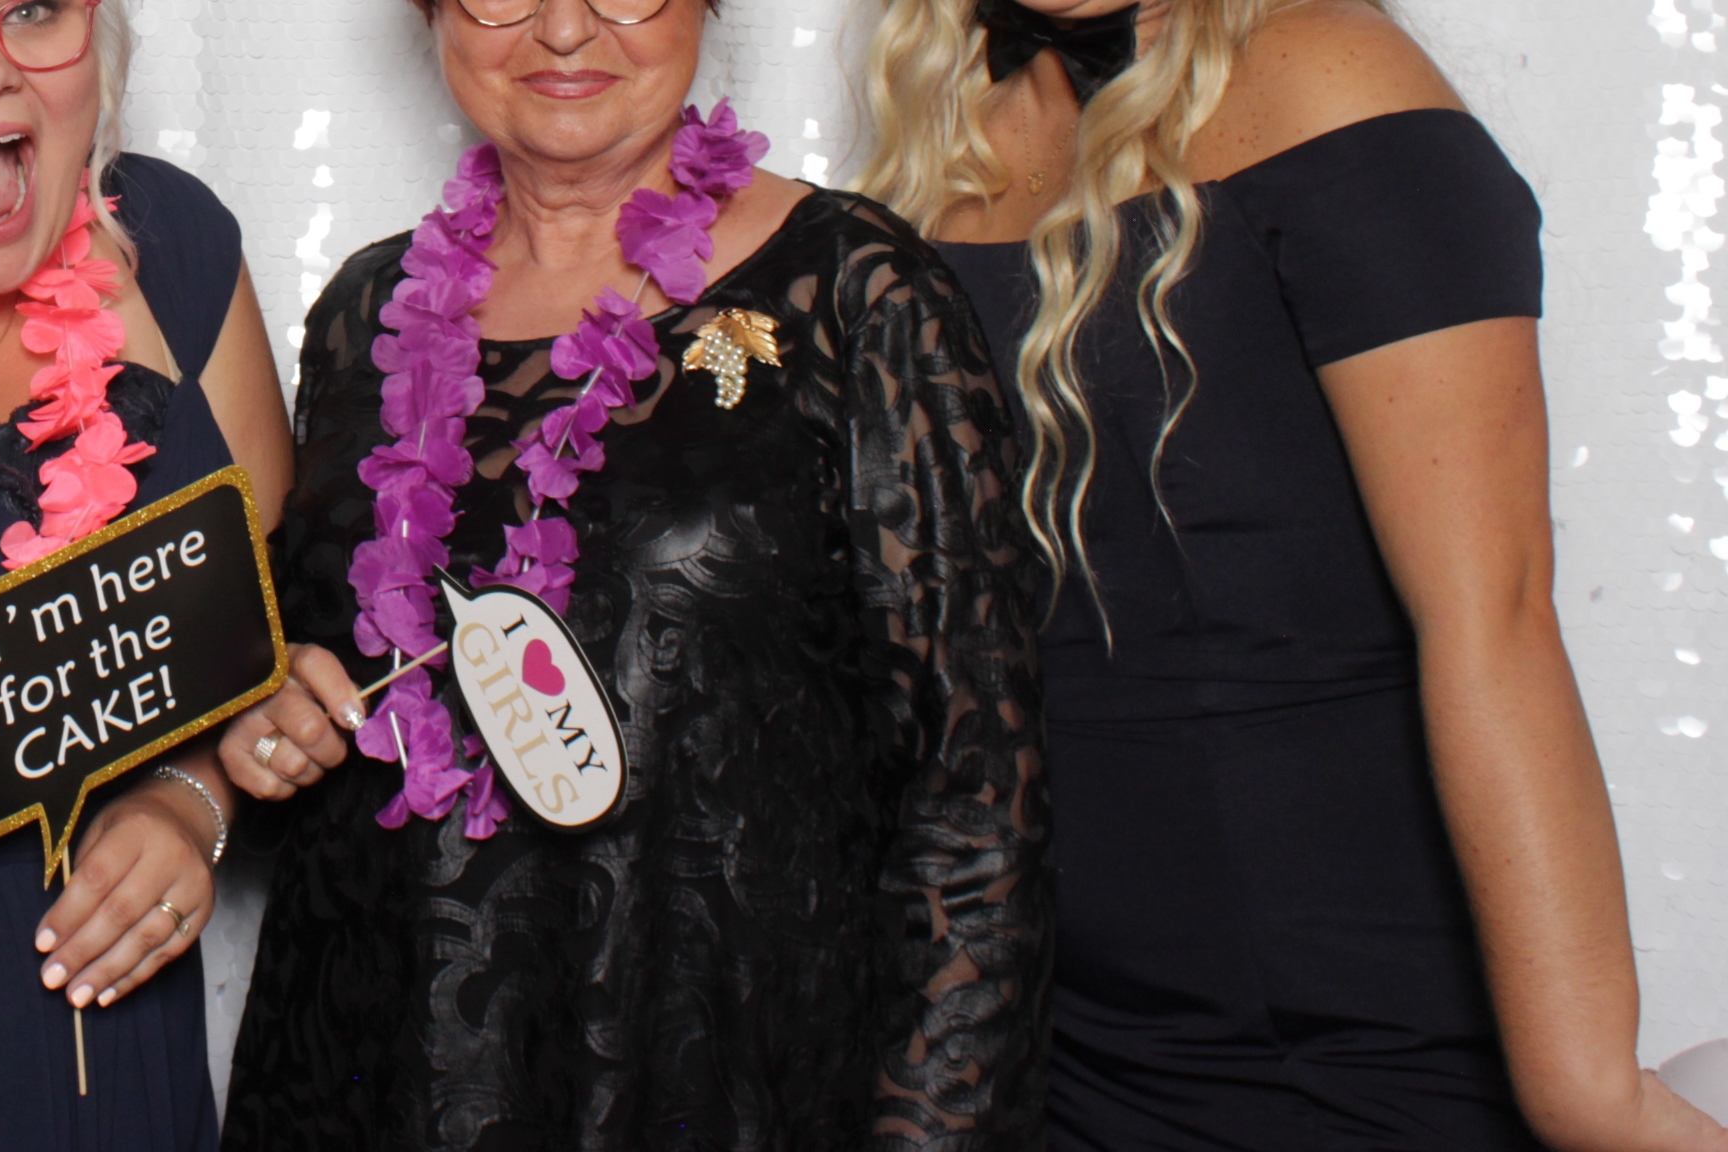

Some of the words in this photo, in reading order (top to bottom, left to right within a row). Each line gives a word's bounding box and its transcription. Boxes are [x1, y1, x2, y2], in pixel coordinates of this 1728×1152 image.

[89, 530, 208, 612] here
[88, 614, 173, 679] the
[500, 613, 529, 640] I
[545, 699, 608, 777] MY
[14, 665, 177, 779] CAKE!
[458, 622, 580, 815] GIRLS
